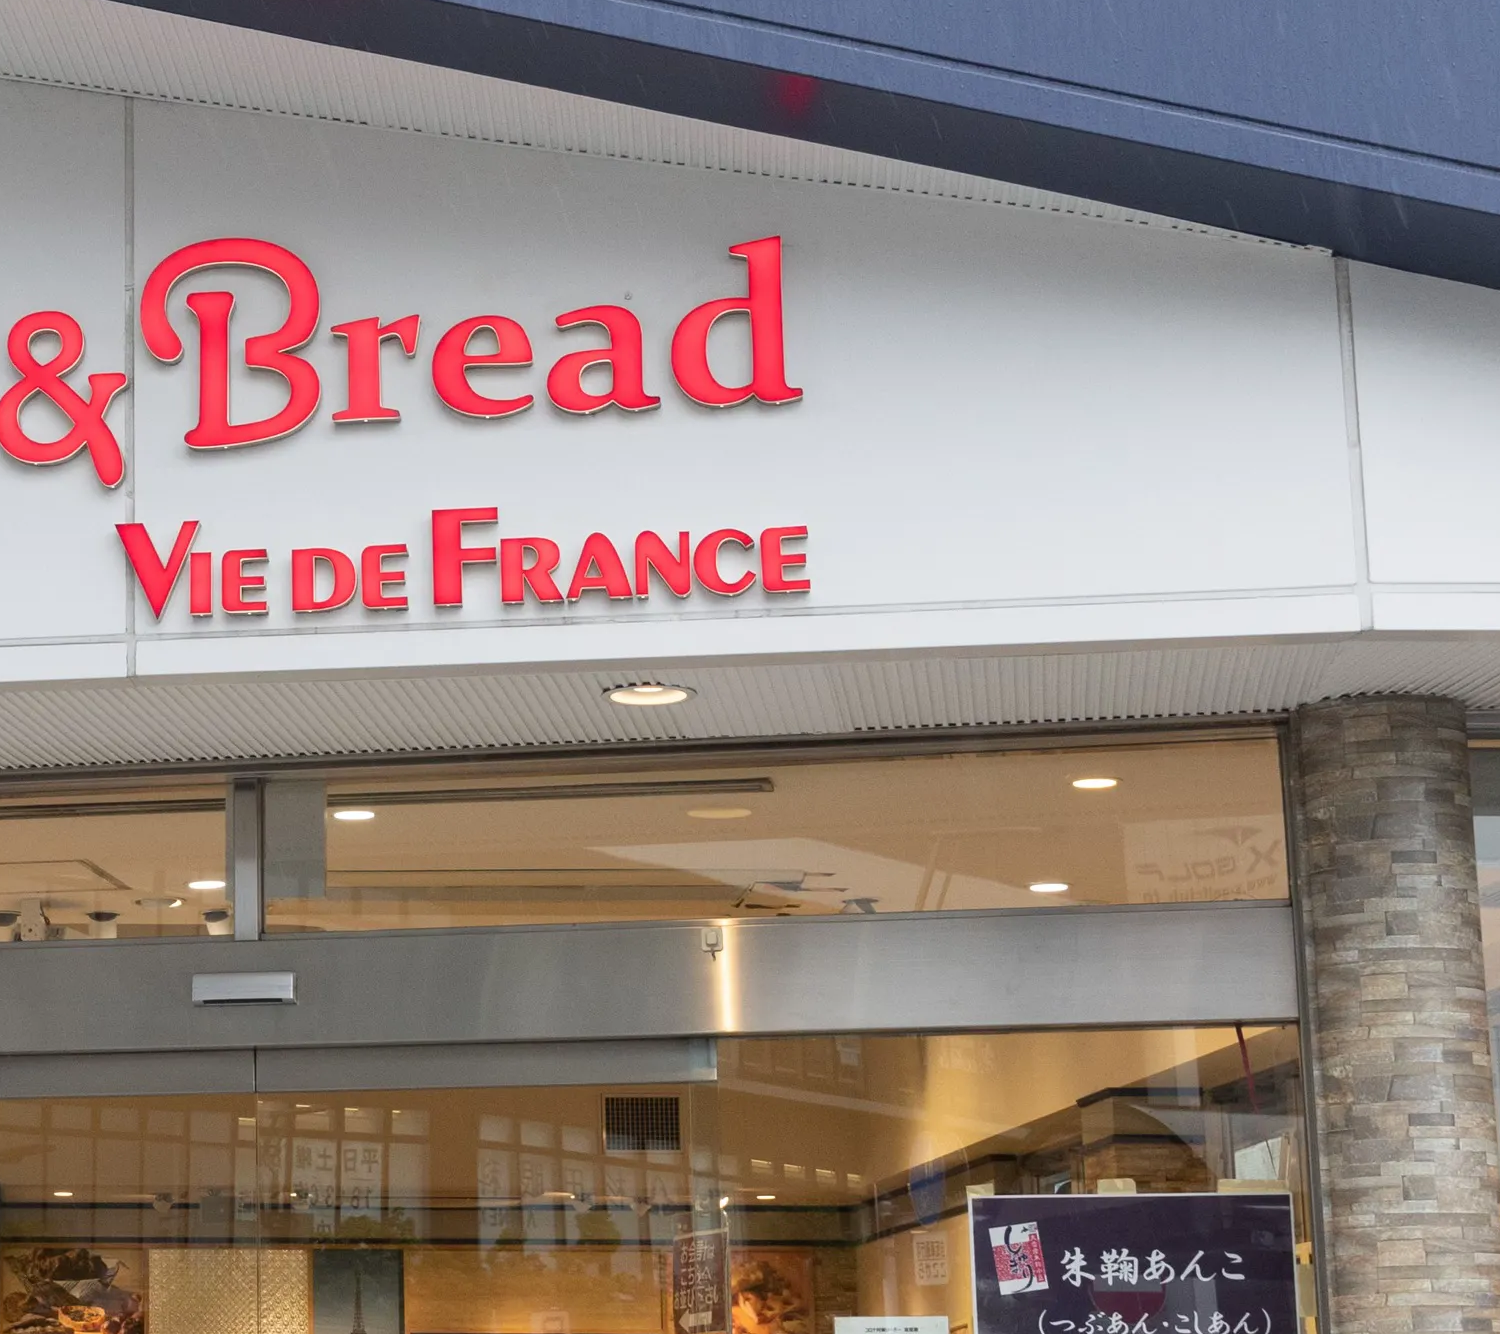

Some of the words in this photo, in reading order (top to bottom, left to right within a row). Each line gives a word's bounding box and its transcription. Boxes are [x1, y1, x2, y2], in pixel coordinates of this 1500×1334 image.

[140, 235, 804, 452] Bread
[115, 518, 270, 621] VIE
[292, 542, 409, 612] DE
[430, 505, 811, 609] FRANCE
[1059, 1246, 1247, 1288] 朱鞠あんこ
